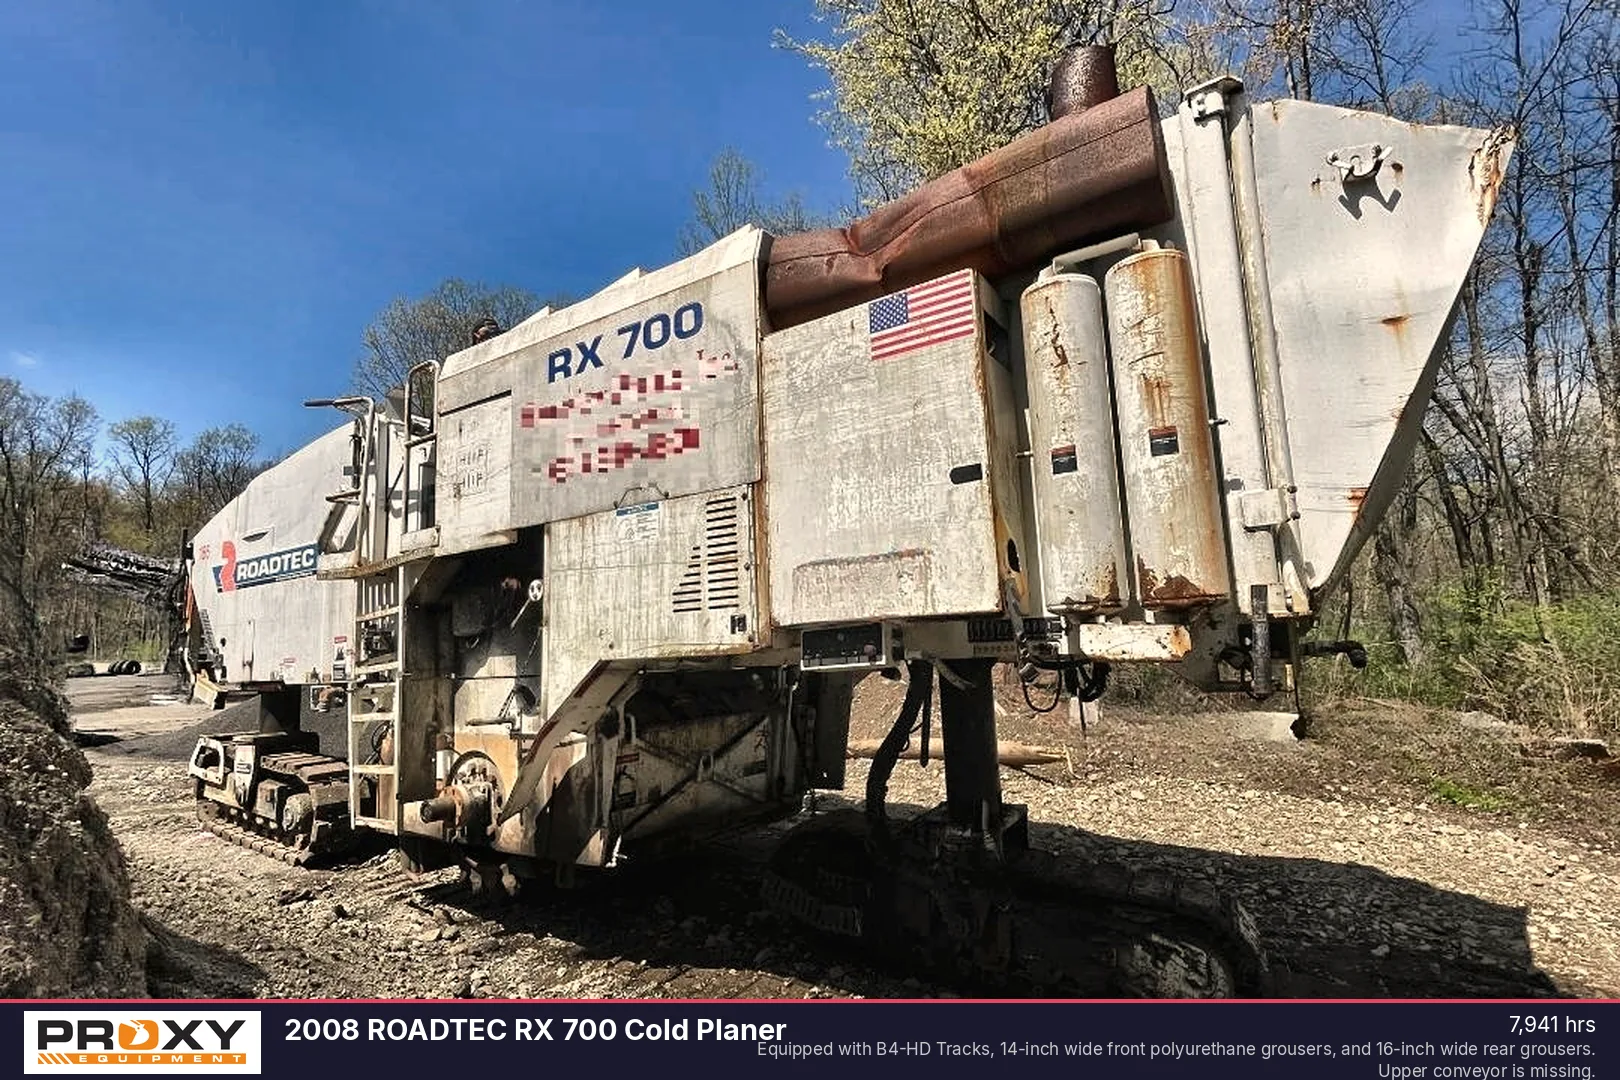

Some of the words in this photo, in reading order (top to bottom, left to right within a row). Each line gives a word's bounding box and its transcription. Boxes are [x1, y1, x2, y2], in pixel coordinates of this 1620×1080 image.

[548, 334, 604, 384] RX
[617, 302, 703, 360] 700
[236, 548, 315, 581] ROADTEC
